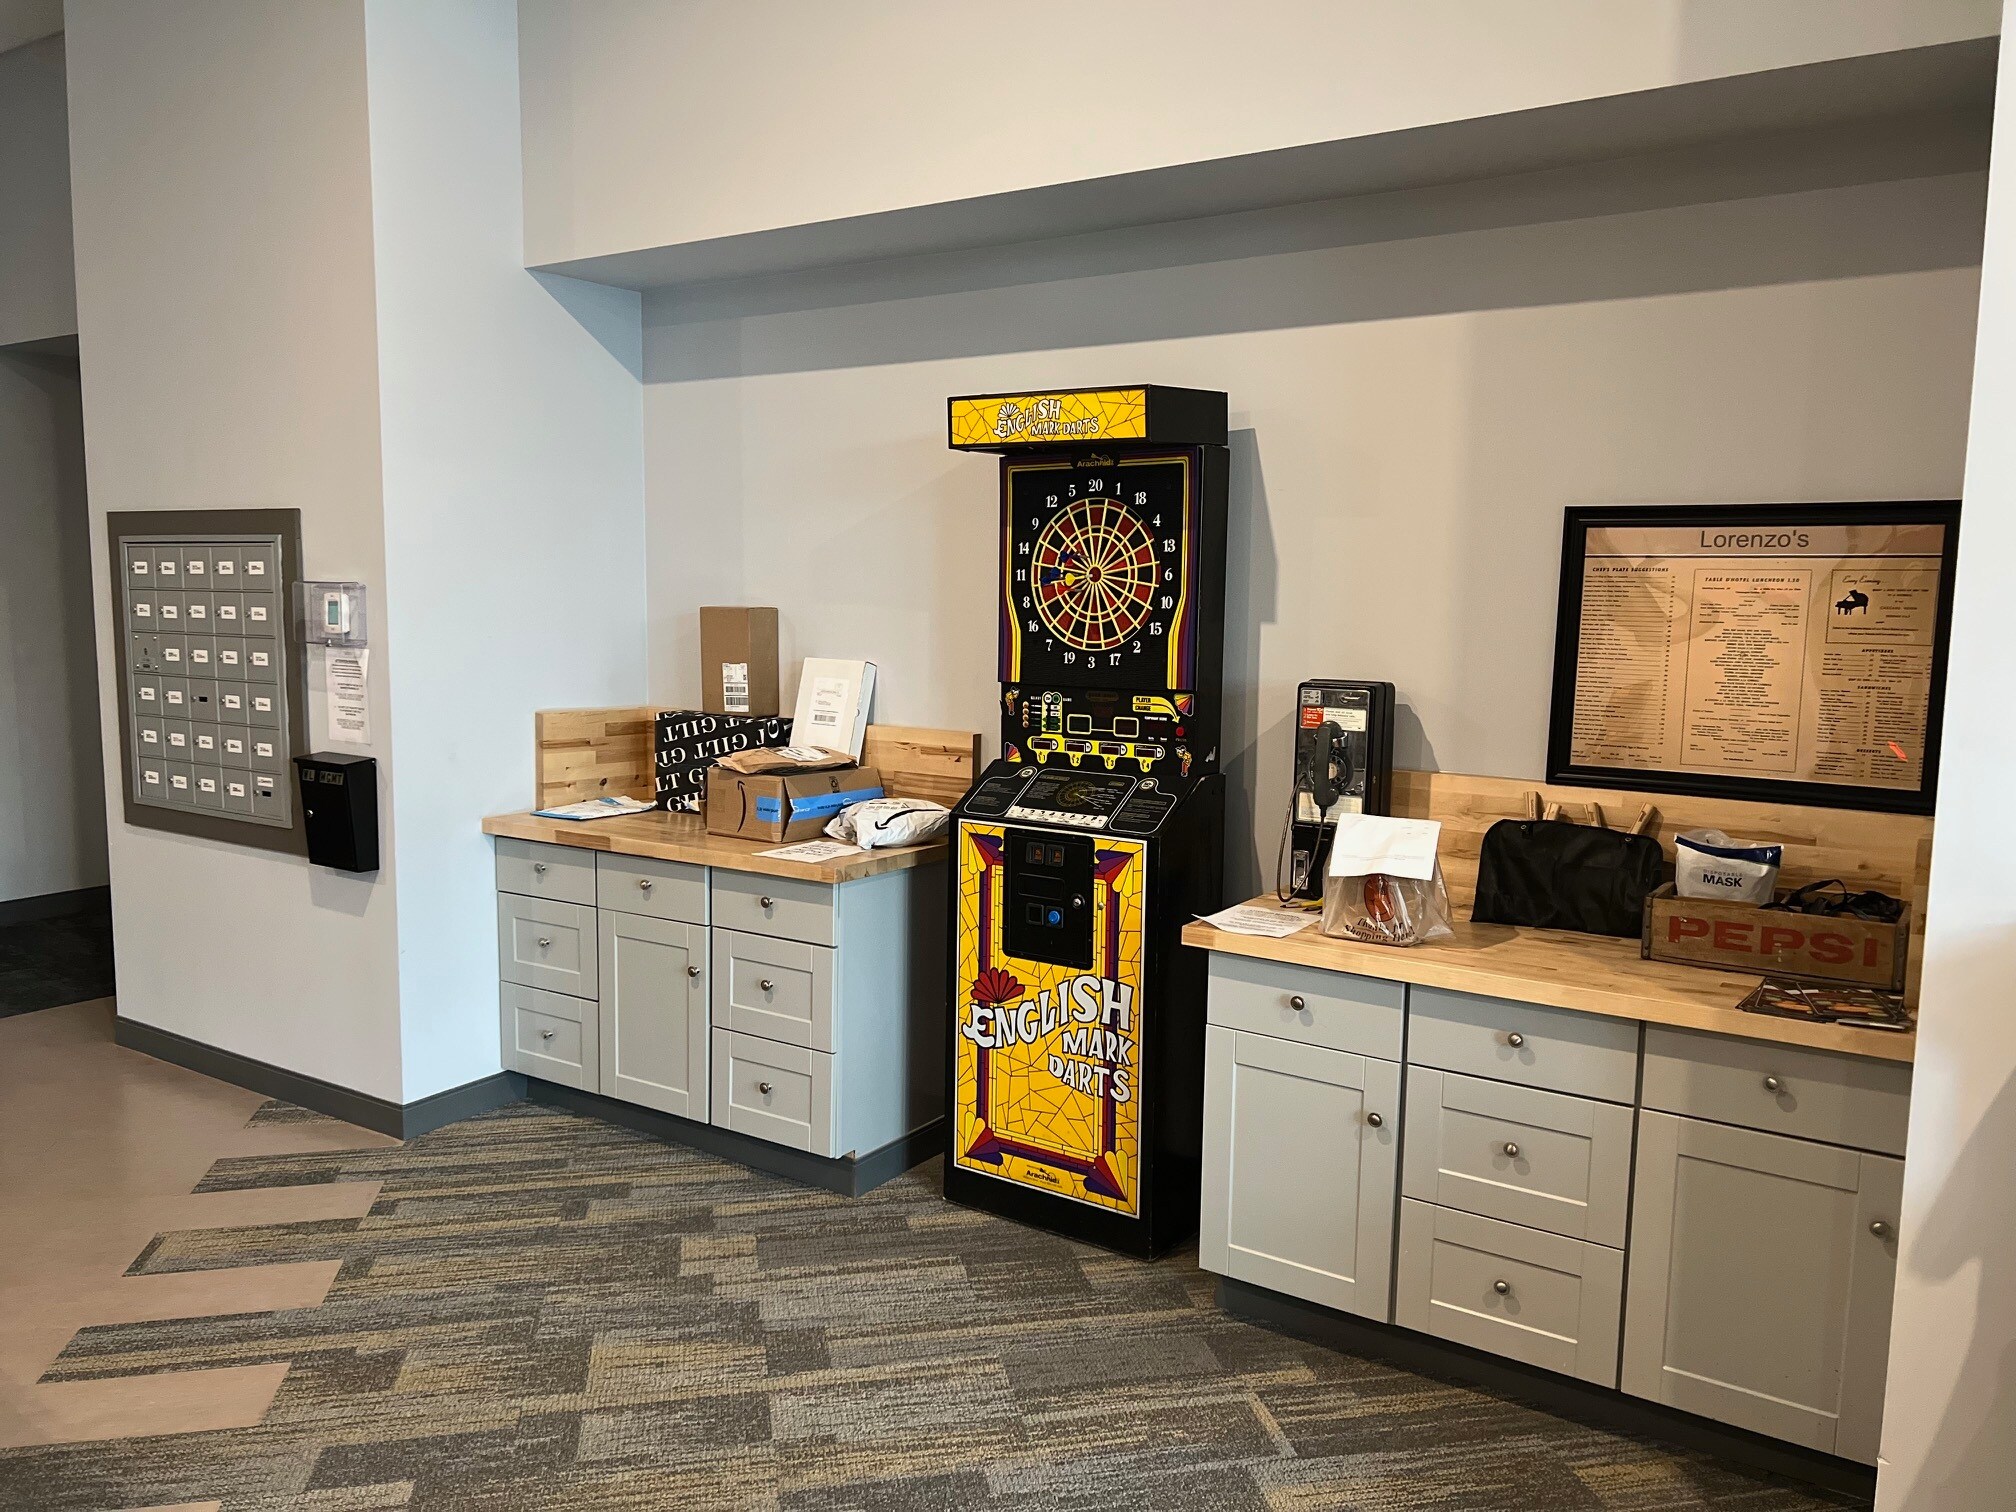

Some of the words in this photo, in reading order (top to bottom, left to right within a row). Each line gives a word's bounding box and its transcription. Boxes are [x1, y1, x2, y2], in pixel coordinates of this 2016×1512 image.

[993, 398, 1062, 438] ENGLISH
[1031, 420, 1060, 436] MARK
[1063, 416, 1099, 435] DARTS
[1069, 484, 1076, 497] 5
[1088, 479, 1103, 492] 20
[1116, 482, 1121, 495] 1
[1045, 495, 1058, 508] 12
[1134, 492, 1147, 505] 18
[1031, 517, 1039, 530] 9
[1153, 514, 1161, 527] 4
[1162, 539, 1176, 552] 13
[1701, 530, 1810, 548] Lorenzo's
[1018, 542, 1029, 554] 14
[1016, 569, 1026, 581] 11
[1164, 568, 1173, 581] 6
[1023, 596, 1030, 608] 8
[1160, 596, 1173, 609] 10
[1028, 620, 1039, 633] 16
[1149, 622, 1162, 635] 15
[1046, 640, 1053, 651] 7
[1132, 641, 1141, 654] 2
[1063, 651, 1075, 665] 19
[1087, 656, 1095, 669] 3
[1109, 653, 1121, 666] 17
[663, 716, 717, 743] GILT
[694, 733, 748, 760] GILT
[1703, 874, 1743, 887] MASK
[1668, 916, 1879, 968] PEPSI
[963, 976, 1133, 1049] ENGLISH
[1062, 1027, 1134, 1067] MARK
[1048, 1054, 1131, 1103] DARTS
